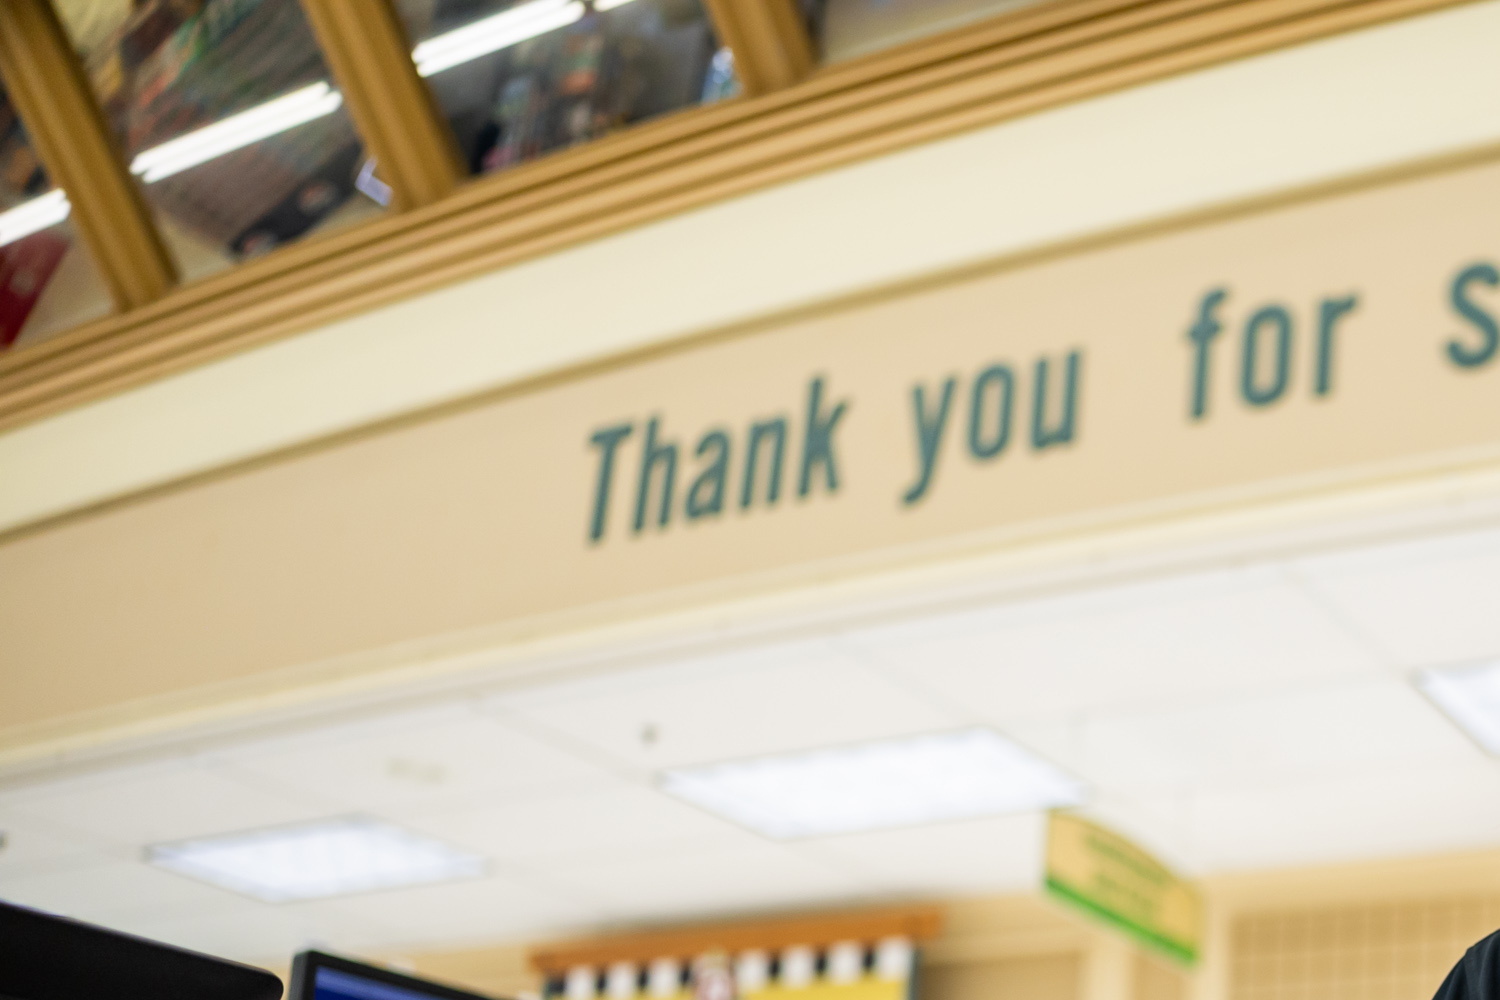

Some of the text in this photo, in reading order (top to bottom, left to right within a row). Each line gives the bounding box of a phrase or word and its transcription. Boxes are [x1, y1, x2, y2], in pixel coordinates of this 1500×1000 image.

[587, 374, 847, 542] Thank
[903, 349, 1081, 505] you
[1186, 288, 1358, 420] for
